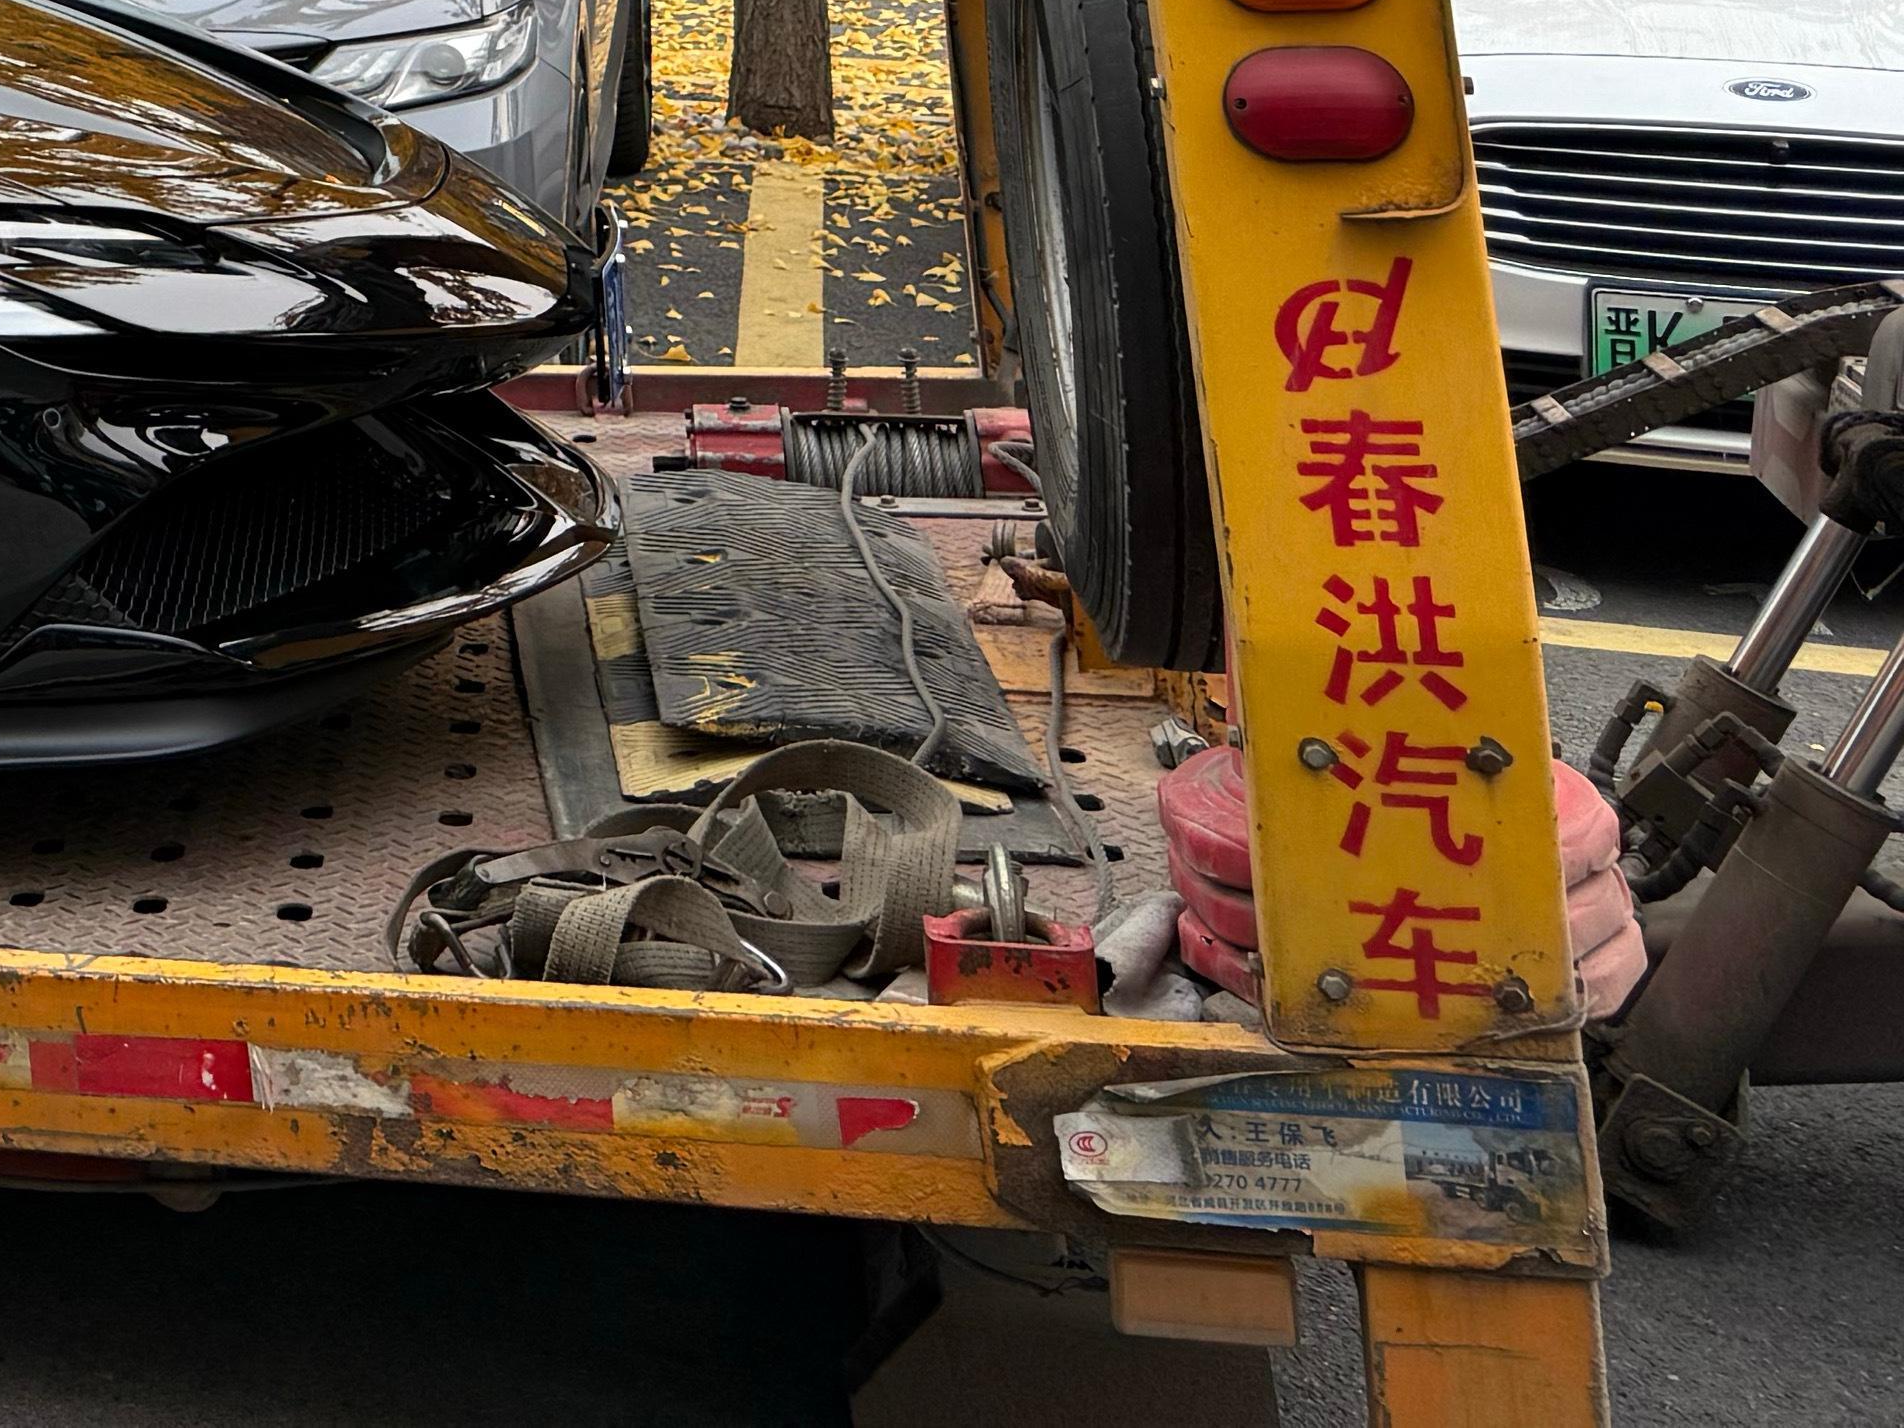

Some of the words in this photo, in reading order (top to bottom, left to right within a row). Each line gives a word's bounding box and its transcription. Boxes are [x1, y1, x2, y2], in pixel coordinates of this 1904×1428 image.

[1743, 82, 1794, 99] Ford
[1298, 409, 1496, 1020] 春洪汽车
[1255, 1175, 1302, 1193] 4777
